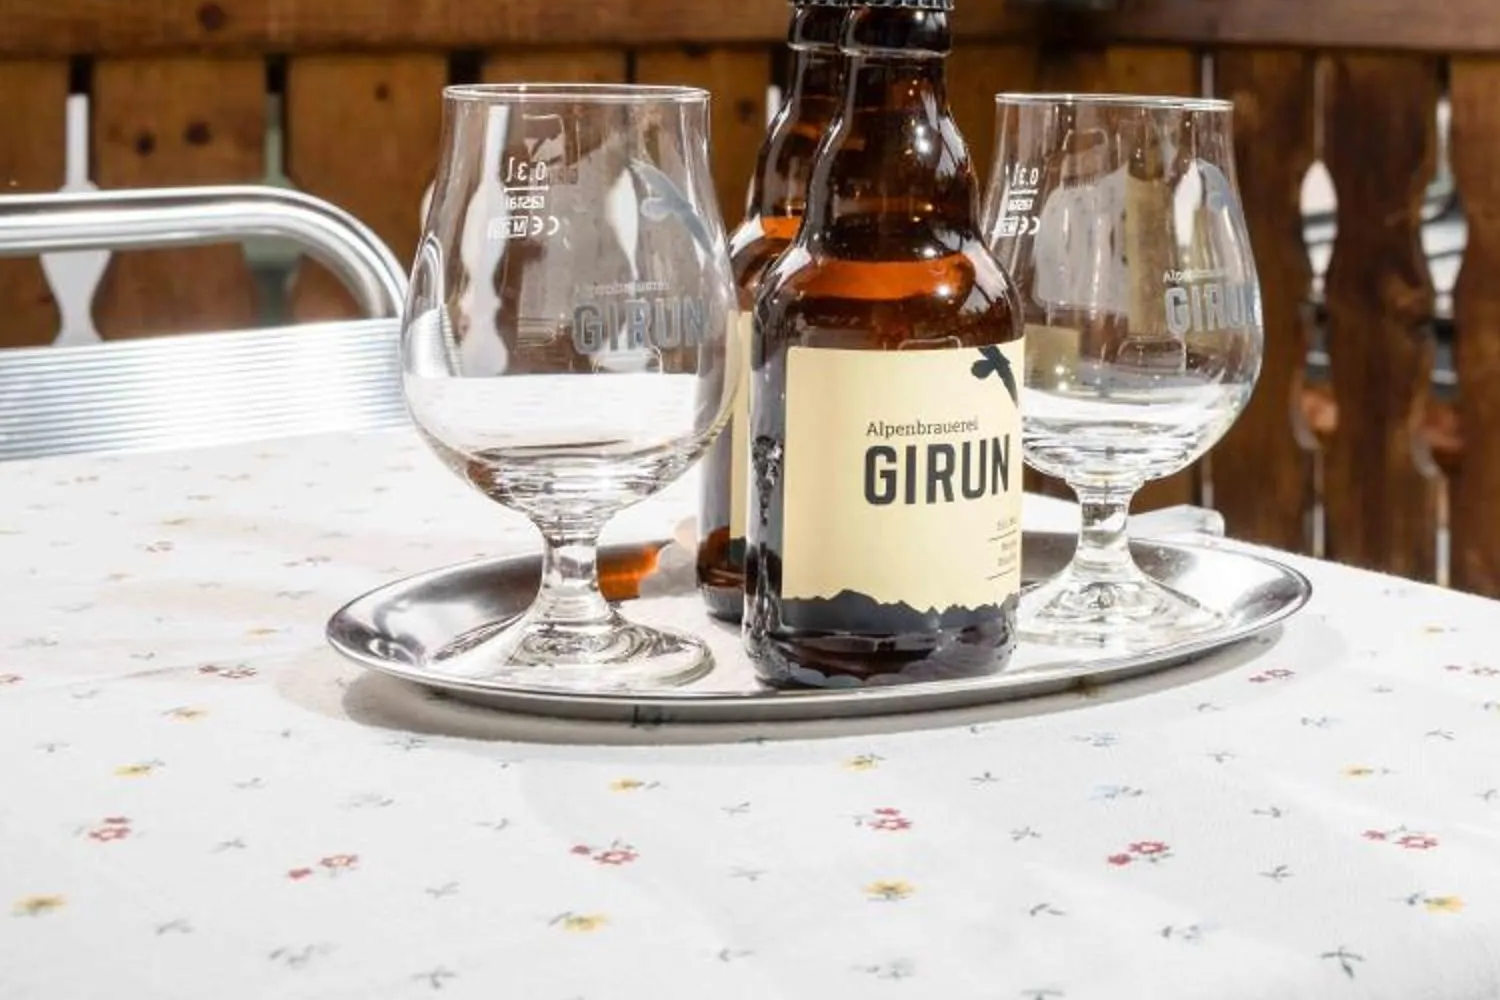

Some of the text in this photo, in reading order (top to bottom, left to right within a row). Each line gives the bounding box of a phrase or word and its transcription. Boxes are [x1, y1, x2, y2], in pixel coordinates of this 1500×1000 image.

[572, 297, 710, 354] GIRUN
[866, 416, 979, 438] Alpenbrauerei
[865, 434, 1010, 505] GIRUN
